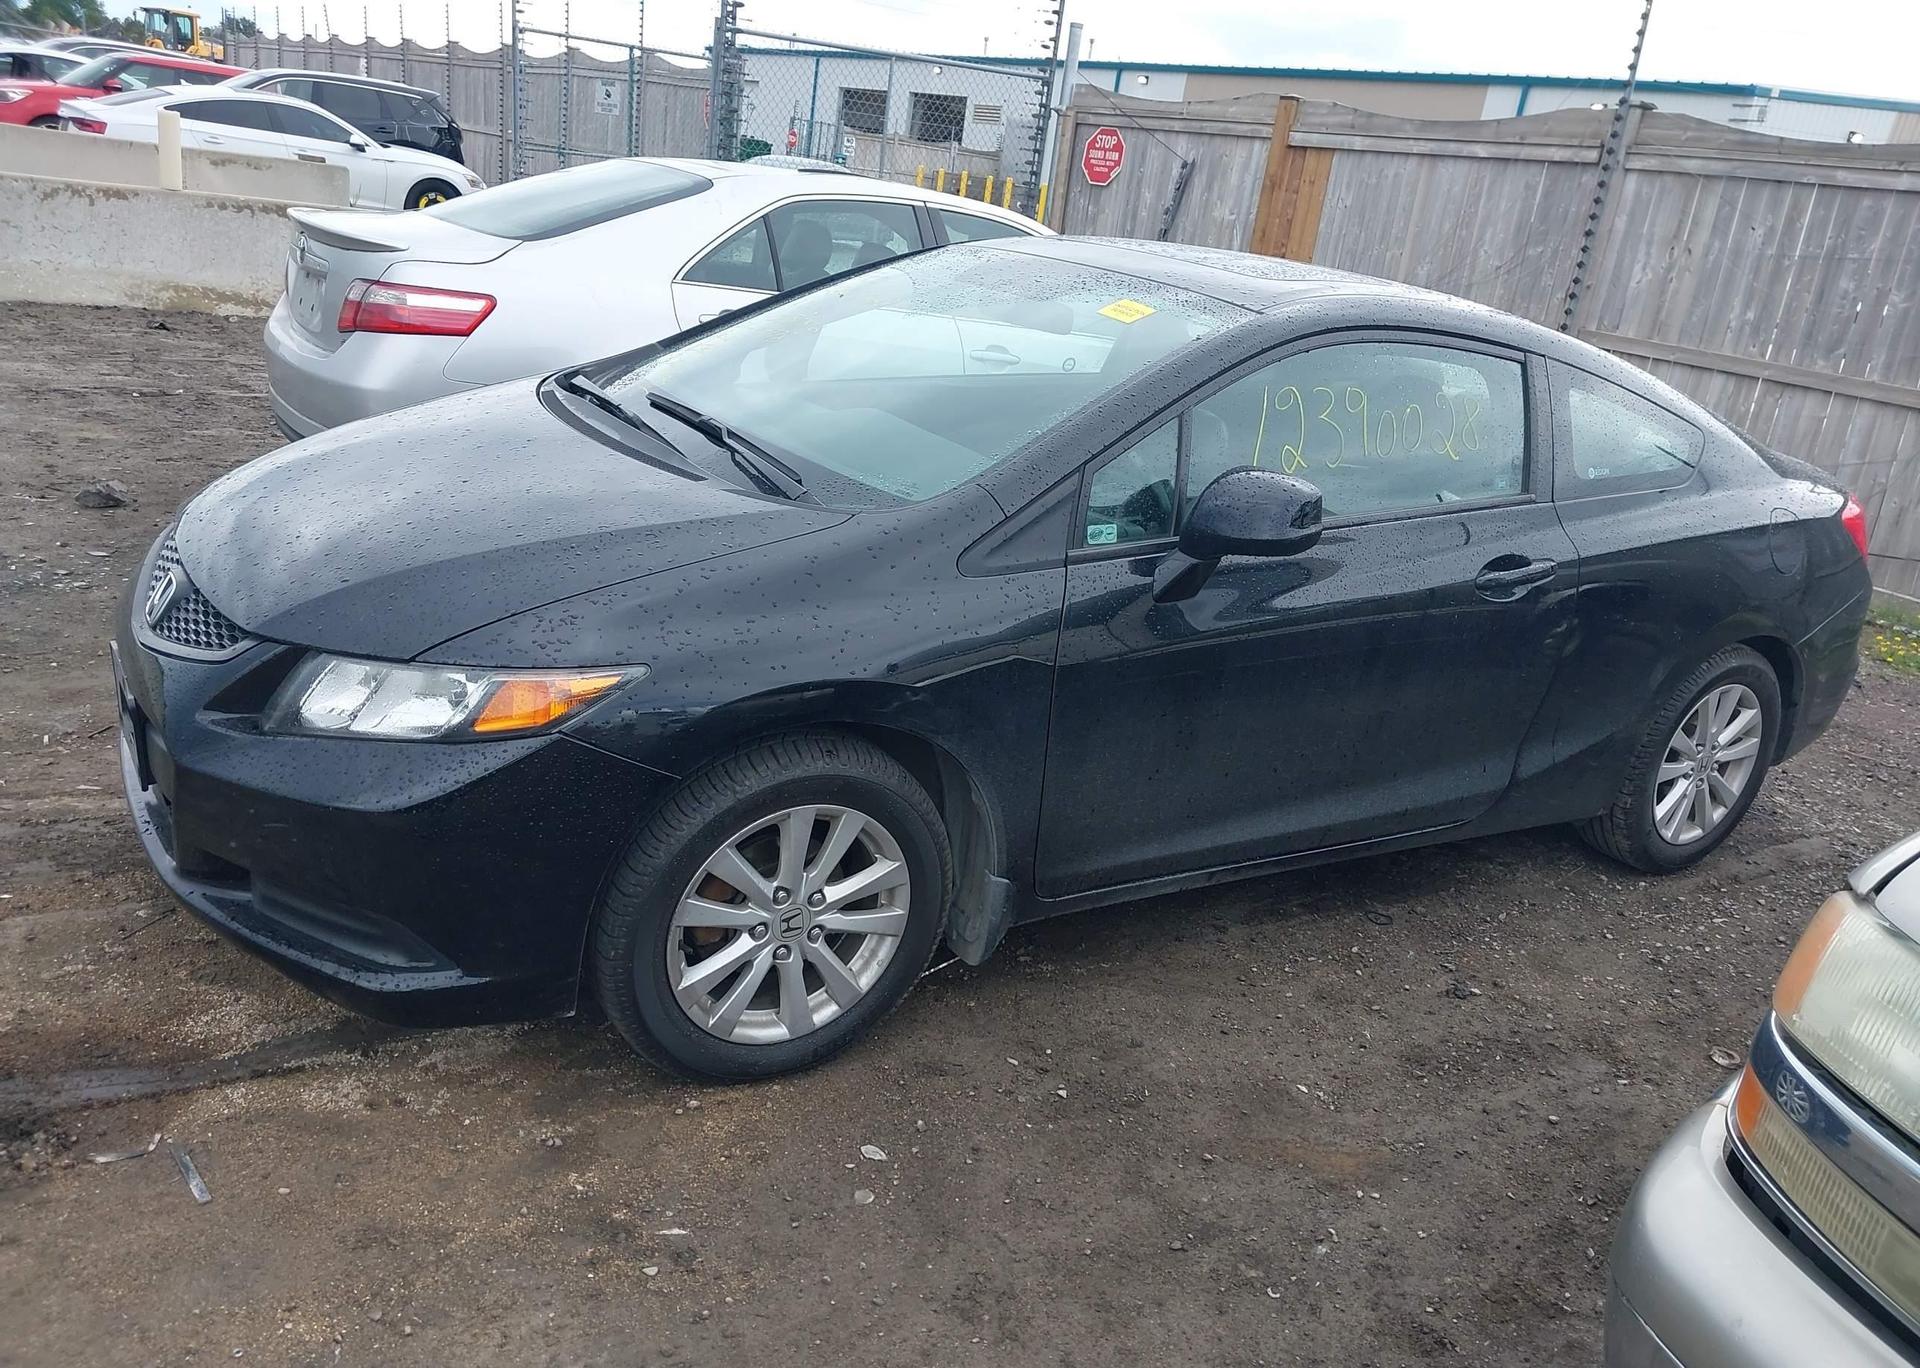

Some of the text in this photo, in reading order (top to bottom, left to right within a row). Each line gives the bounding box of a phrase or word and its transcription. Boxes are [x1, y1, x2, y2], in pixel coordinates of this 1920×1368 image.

[1095, 134, 1118, 148] STOP
[1088, 149, 1105, 159] SOUND
[1253, 385, 1480, 474] 12390028
